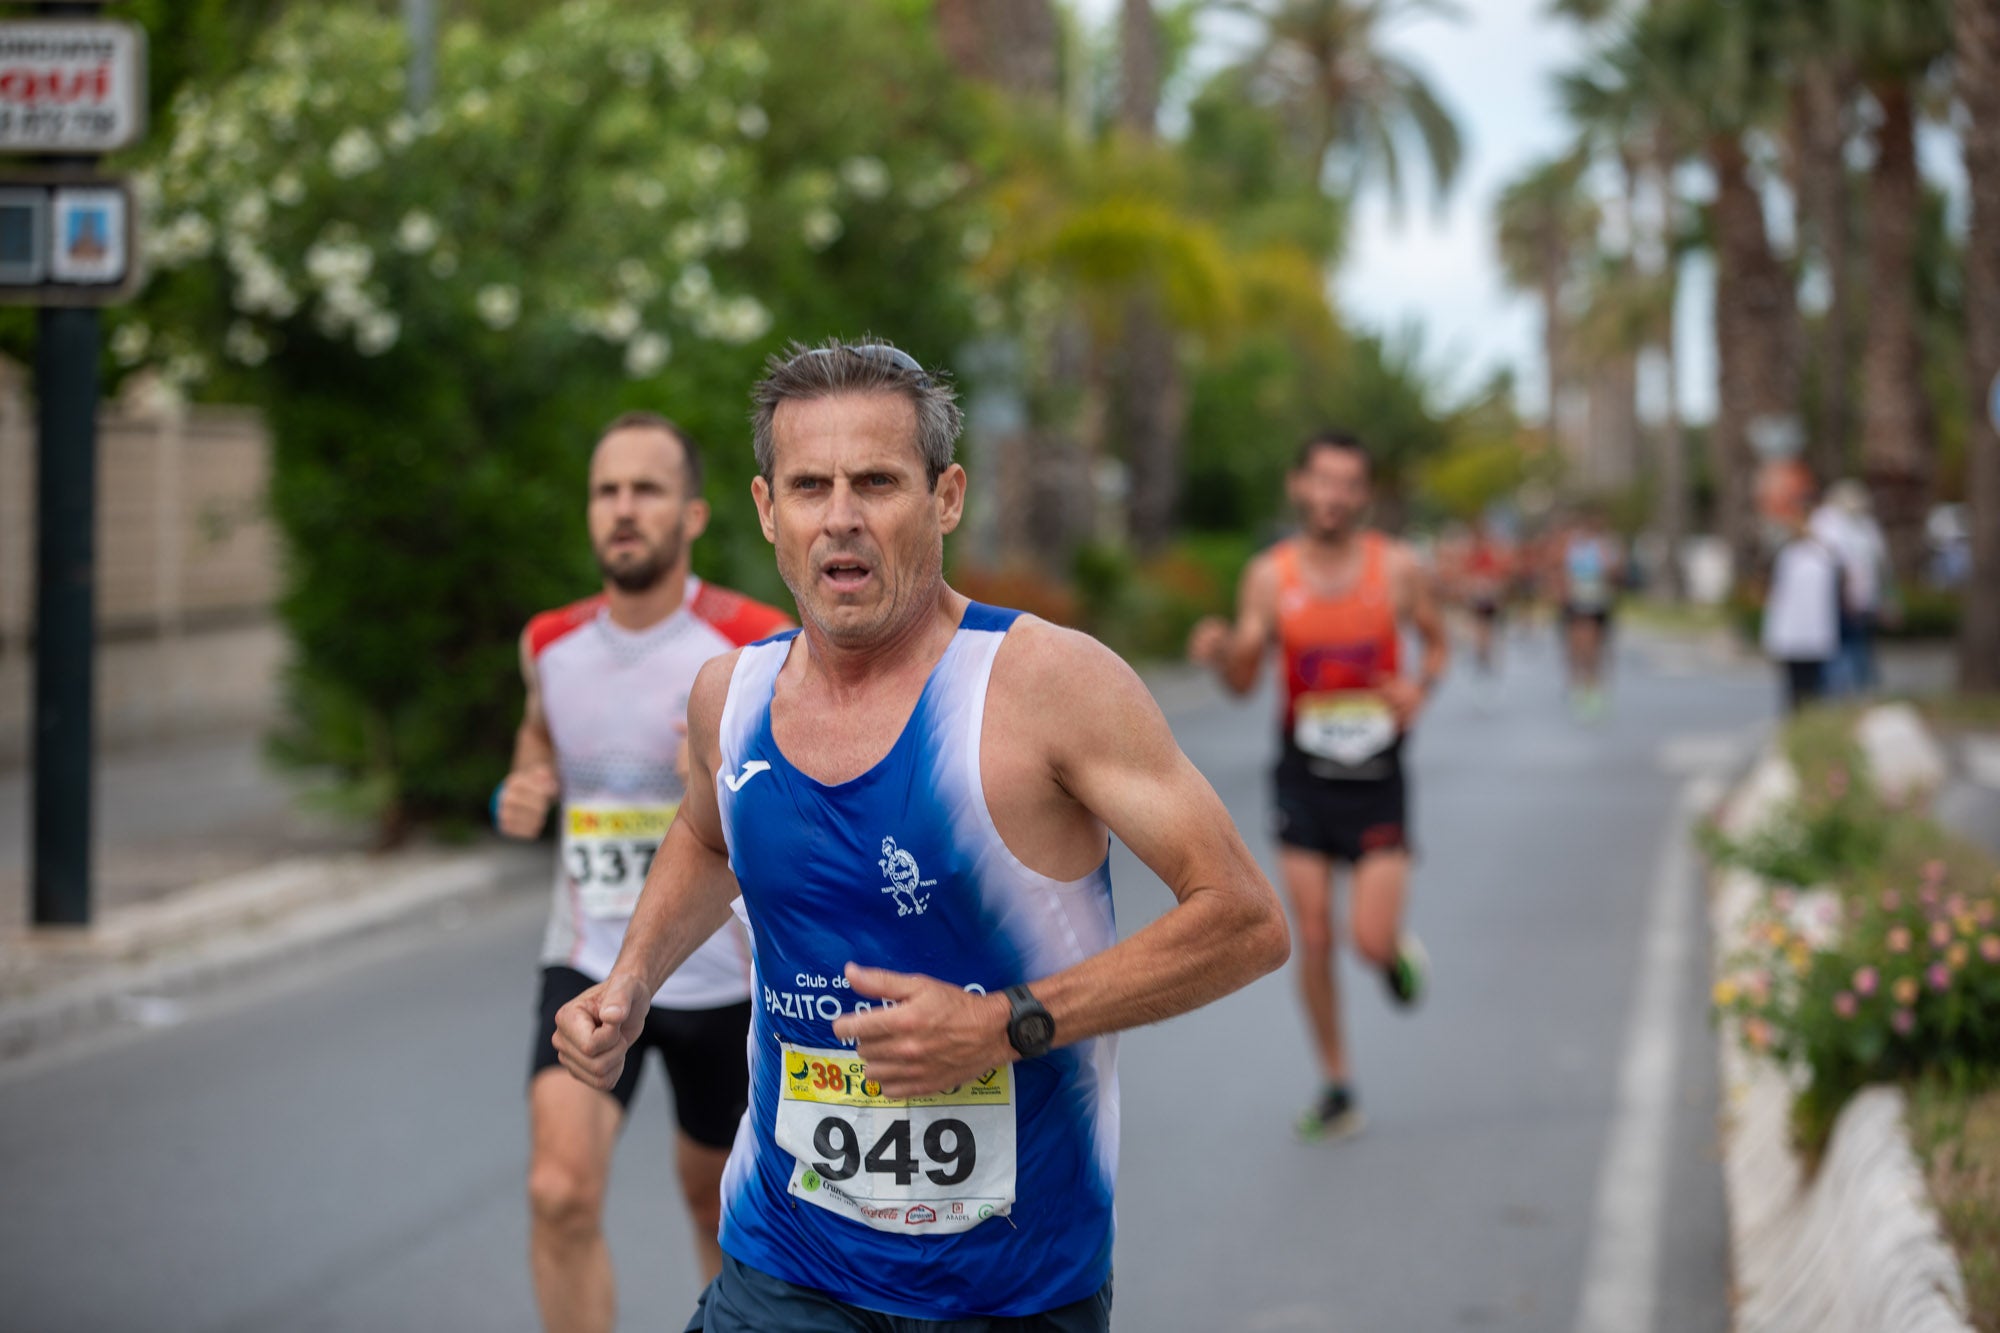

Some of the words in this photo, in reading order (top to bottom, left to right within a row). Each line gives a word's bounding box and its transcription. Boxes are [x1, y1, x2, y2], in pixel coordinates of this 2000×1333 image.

[795, 973, 828, 988] Club
[832, 975, 851, 989] de
[764, 985, 843, 1021] PAZITO
[811, 1061, 845, 1092] 38
[811, 1116, 977, 1186] 949
